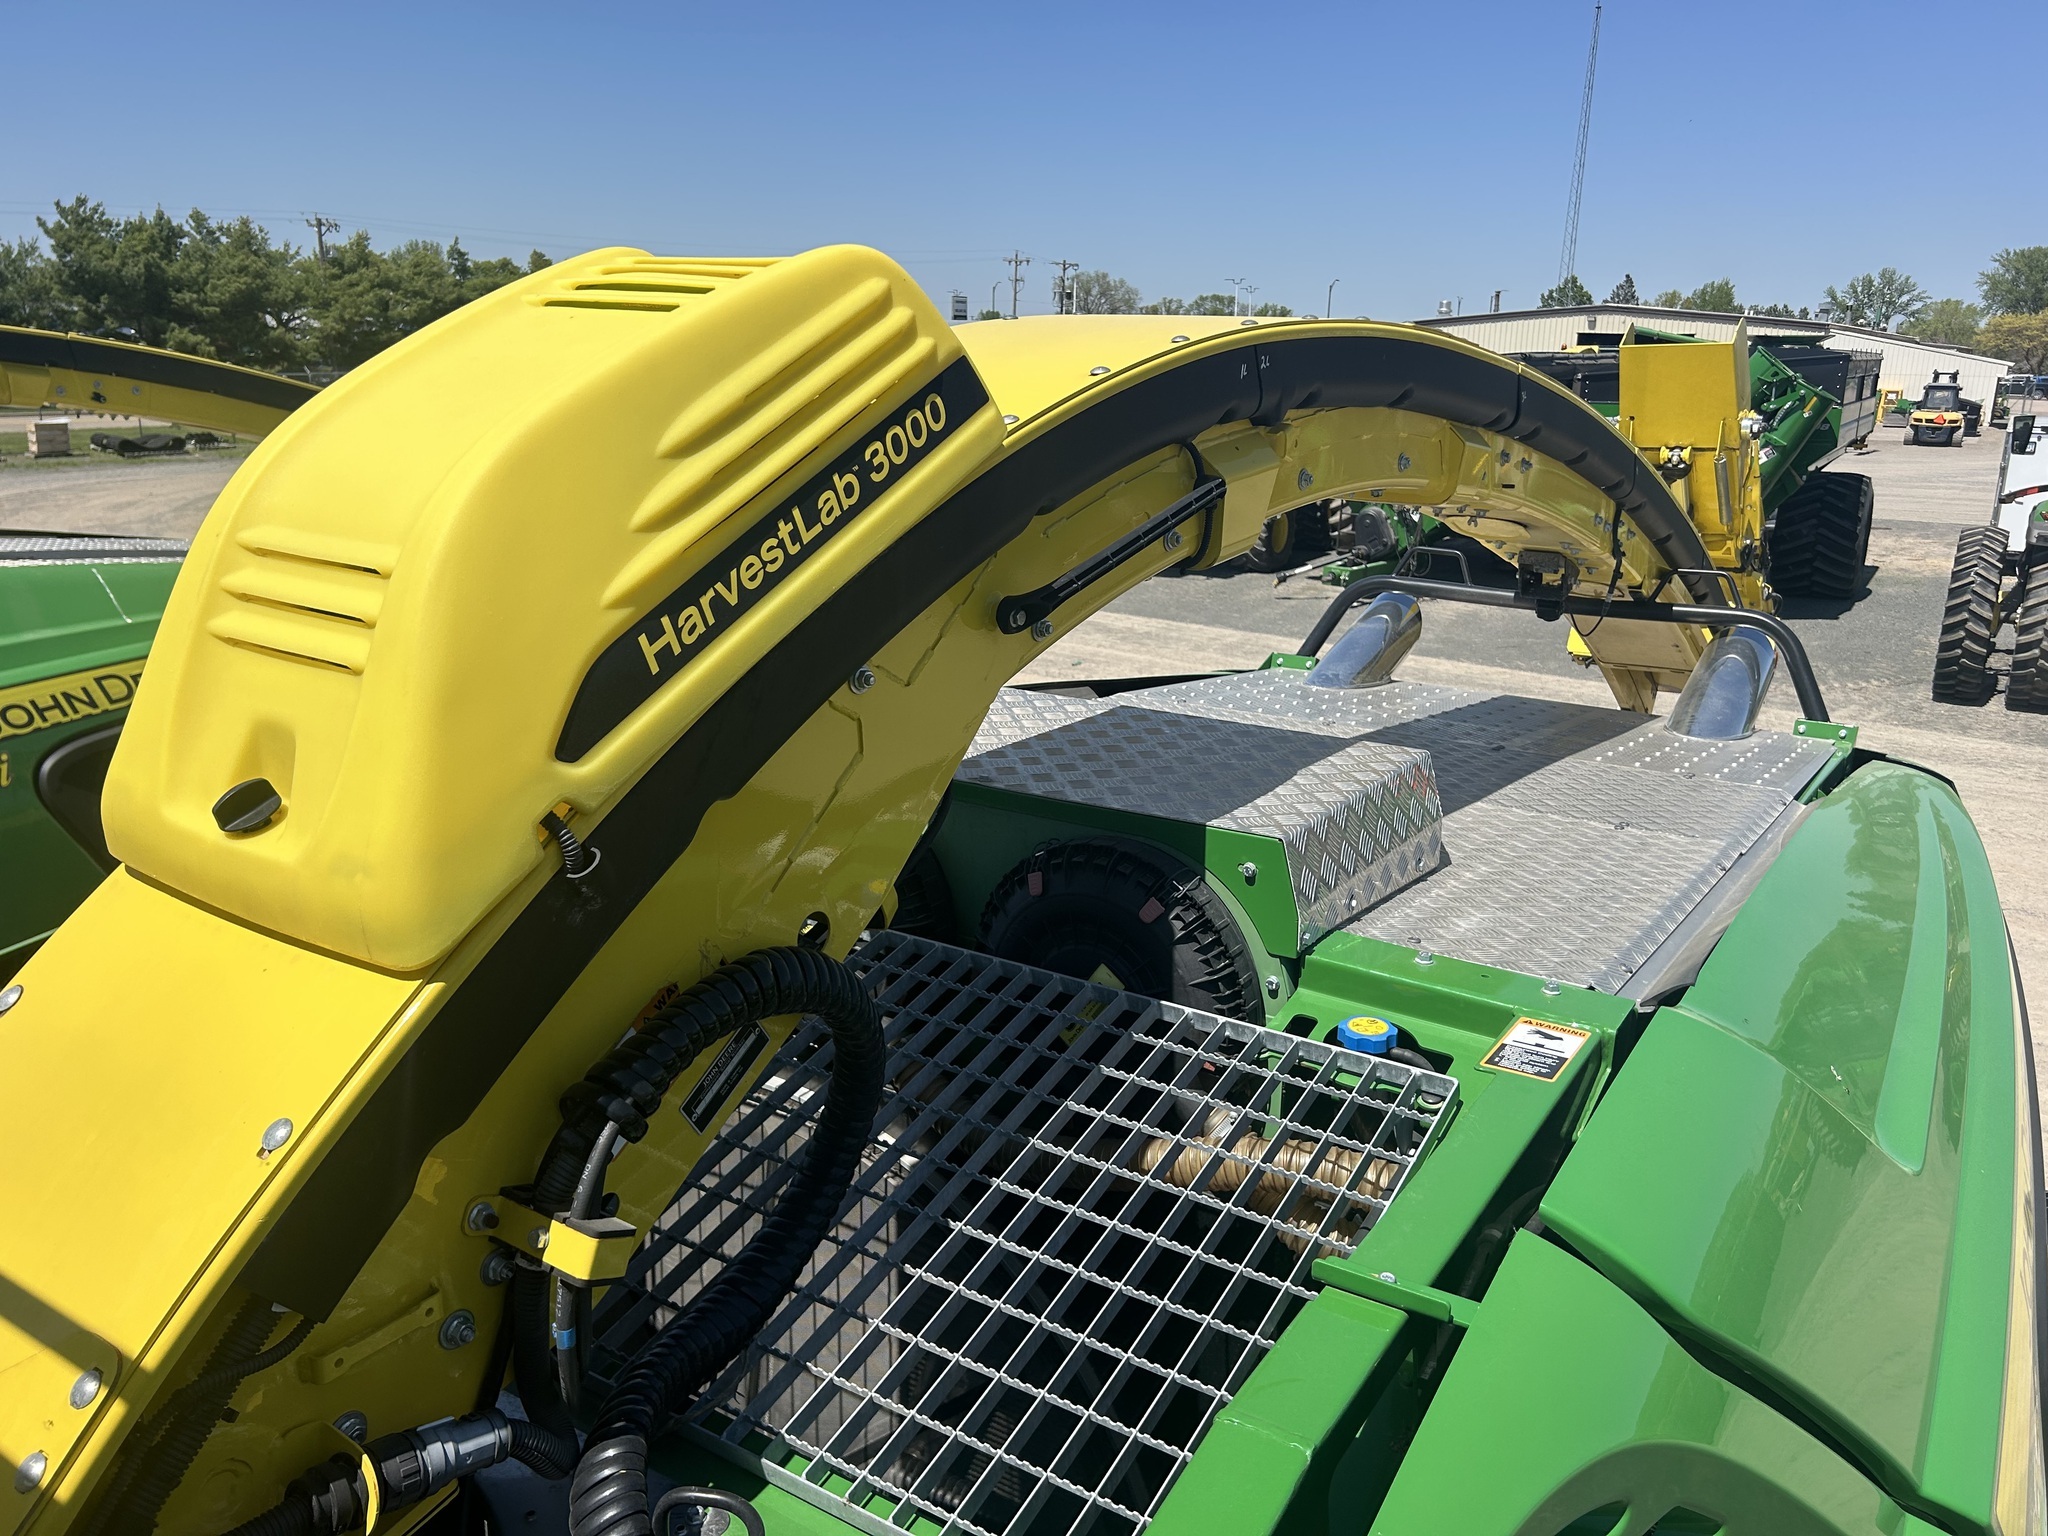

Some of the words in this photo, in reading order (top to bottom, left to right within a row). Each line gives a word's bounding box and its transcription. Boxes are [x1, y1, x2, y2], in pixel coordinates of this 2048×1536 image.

[864, 392, 948, 484] 3000
[0, 686, 100, 734] OHN
[1535, 1021, 1586, 1038] WARNING
[703, 1066, 719, 1087] JOHN
[718, 1042, 737, 1066] DEERE
